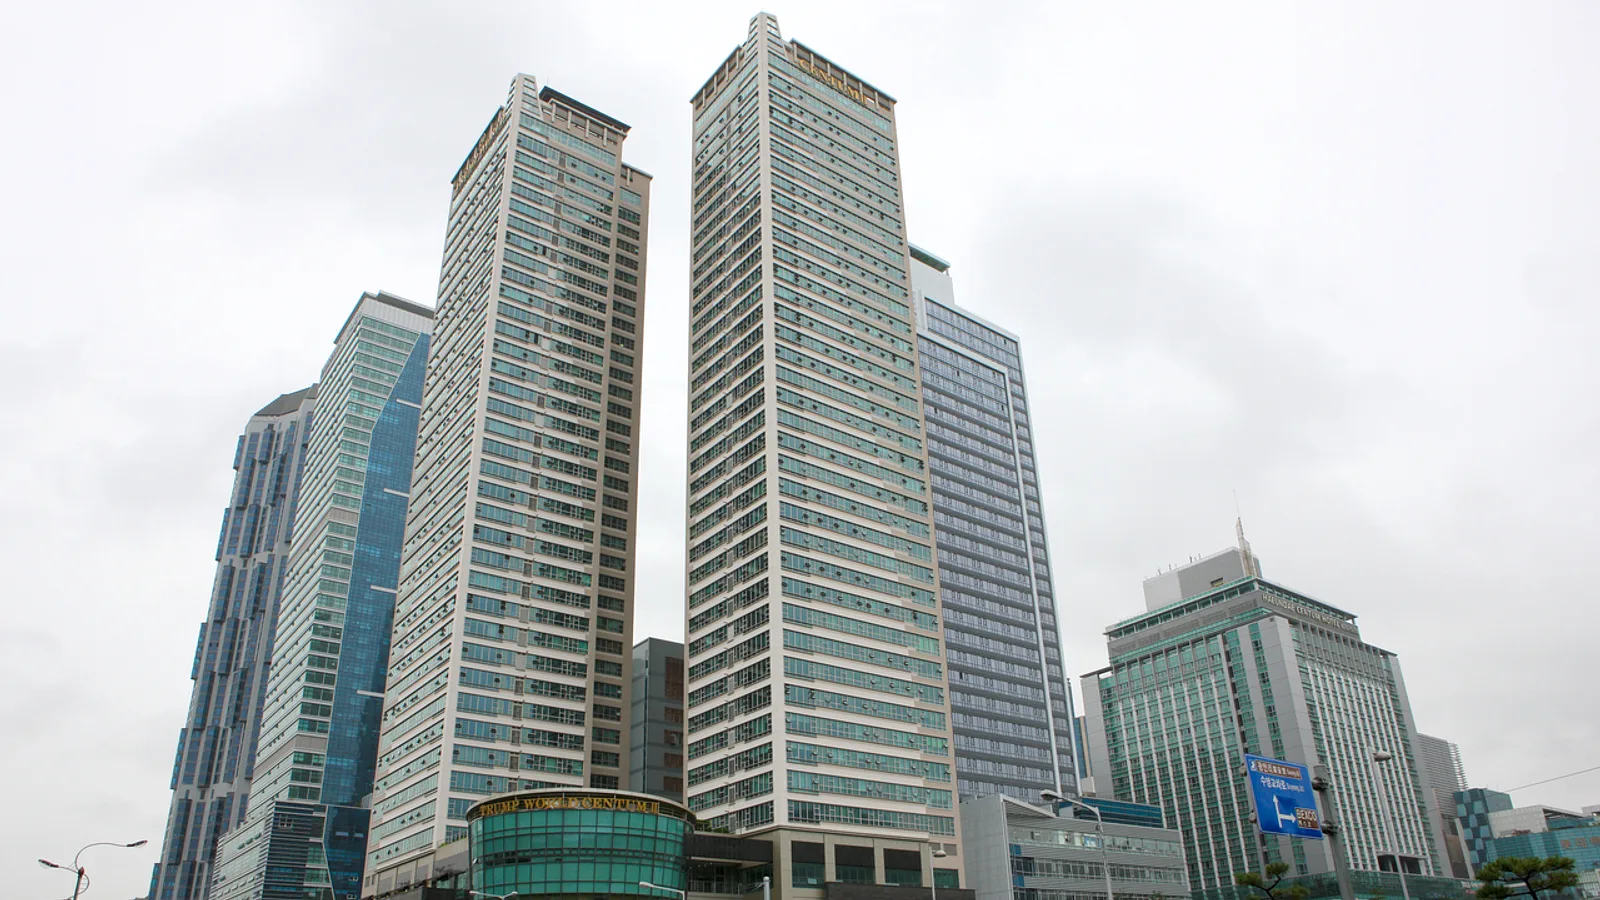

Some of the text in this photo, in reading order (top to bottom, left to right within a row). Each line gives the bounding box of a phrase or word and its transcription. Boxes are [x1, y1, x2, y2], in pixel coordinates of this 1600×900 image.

[480, 800, 519, 816] TRUMP
[524, 797, 579, 809] WORLD
[581, 797, 647, 812] CENTUM
[1297, 809, 1317, 821] BEXCO
